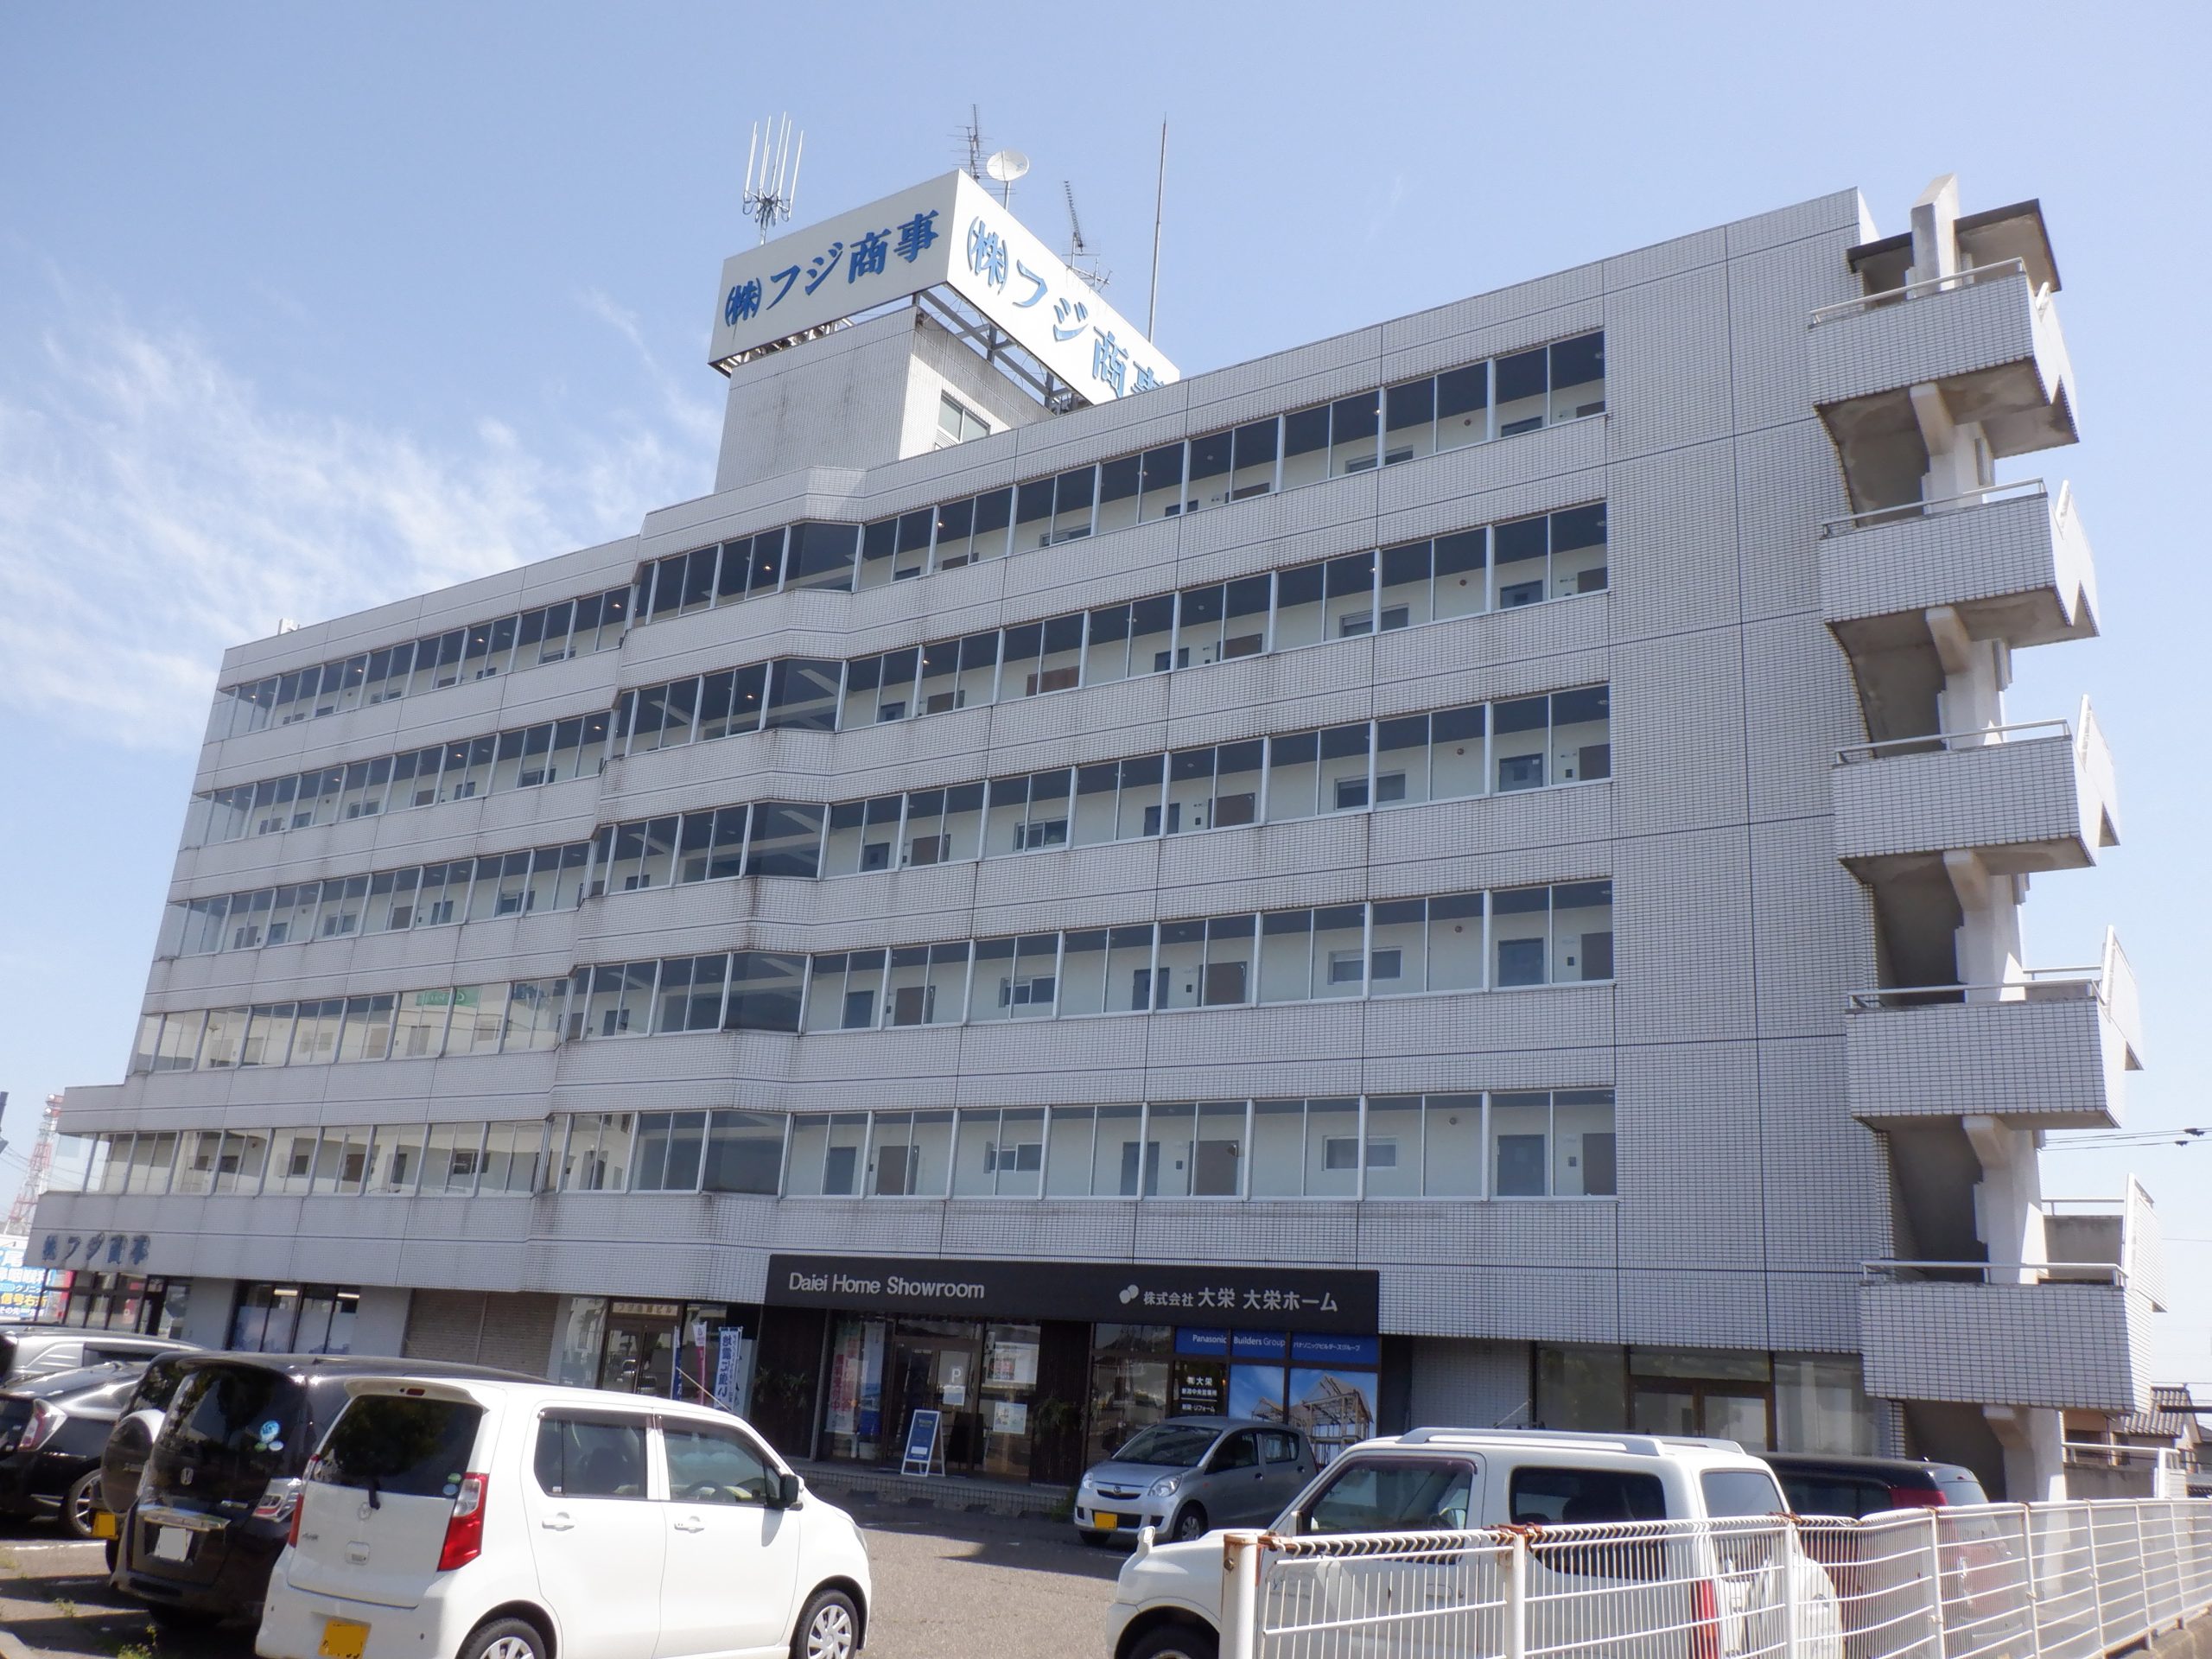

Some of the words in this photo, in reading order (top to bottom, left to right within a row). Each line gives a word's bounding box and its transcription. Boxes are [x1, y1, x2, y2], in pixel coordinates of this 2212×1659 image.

[789, 1272, 829, 1292] Daiei
[832, 1274, 881, 1294] Home
[887, 1275, 985, 1299] Showroom
[1143, 1291, 1194, 1307] 株式会社
[1198, 1287, 1236, 1308] 大栄
[1243, 1288, 1338, 1312] 大栄ホーム
[1192, 1333, 1227, 1344] Panasonic
[1233, 1336, 1262, 1345] Builders
[1263, 1337, 1286, 1348] Group
